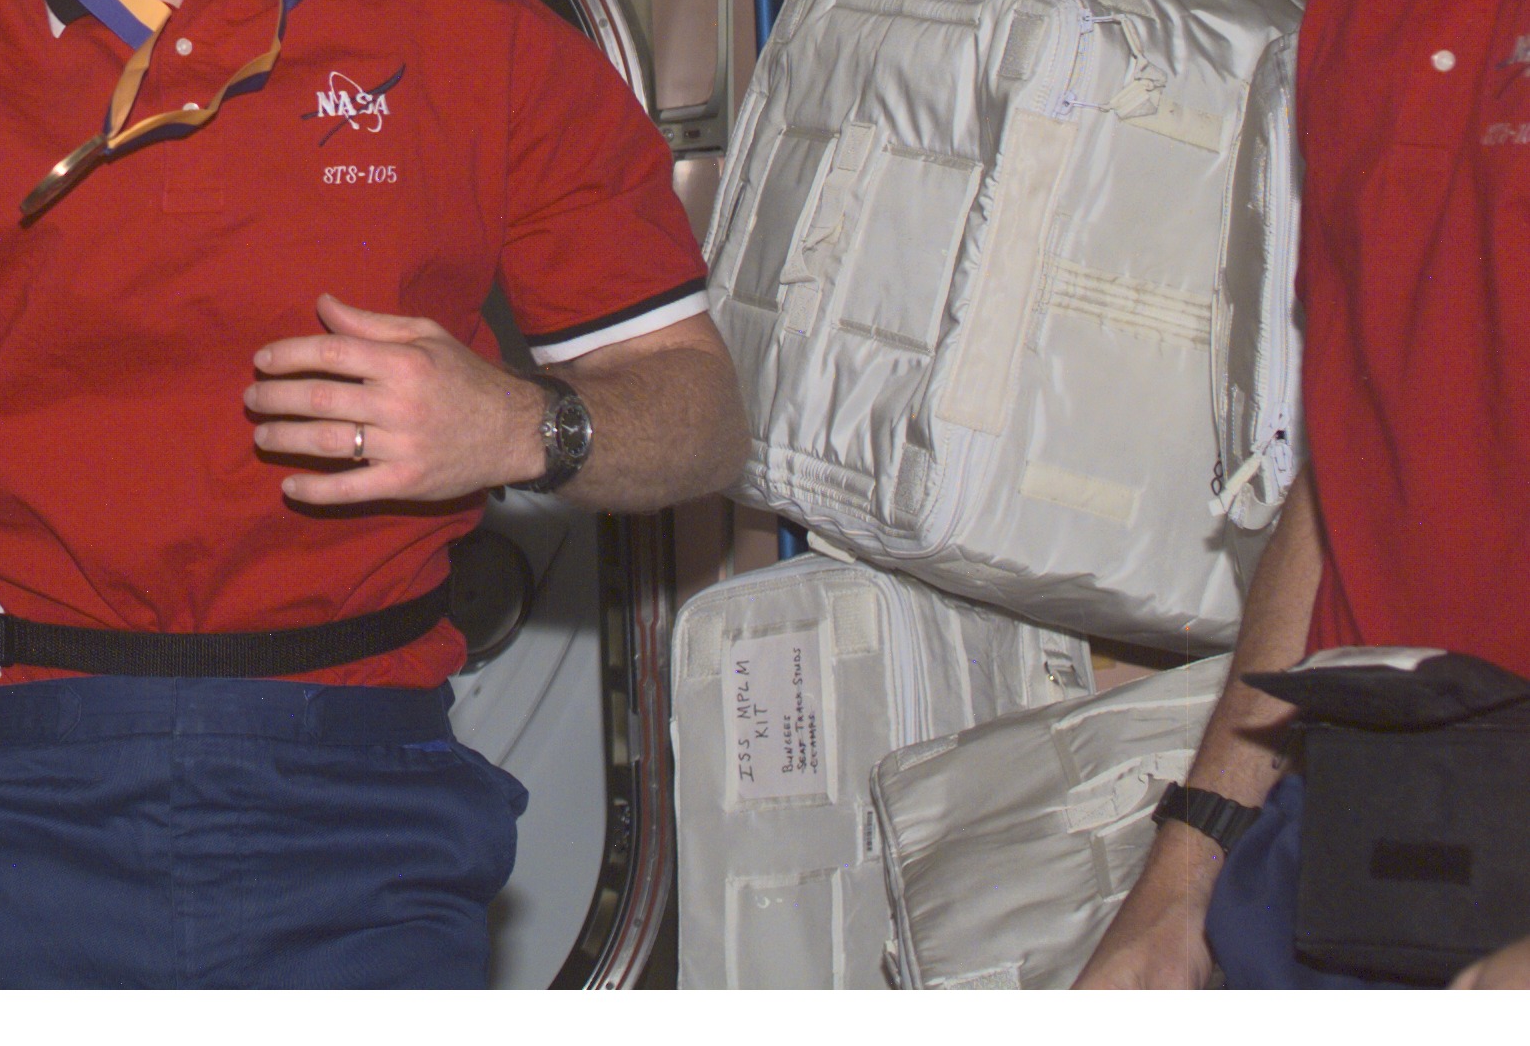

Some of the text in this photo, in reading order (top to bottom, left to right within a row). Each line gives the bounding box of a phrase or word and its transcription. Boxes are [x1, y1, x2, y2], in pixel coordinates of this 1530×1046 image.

[316, 90, 391, 117] NASA
[322, 165, 398, 185] STS-105
[753, 704, 769, 740] KIT
[738, 738, 755, 783] ISS
